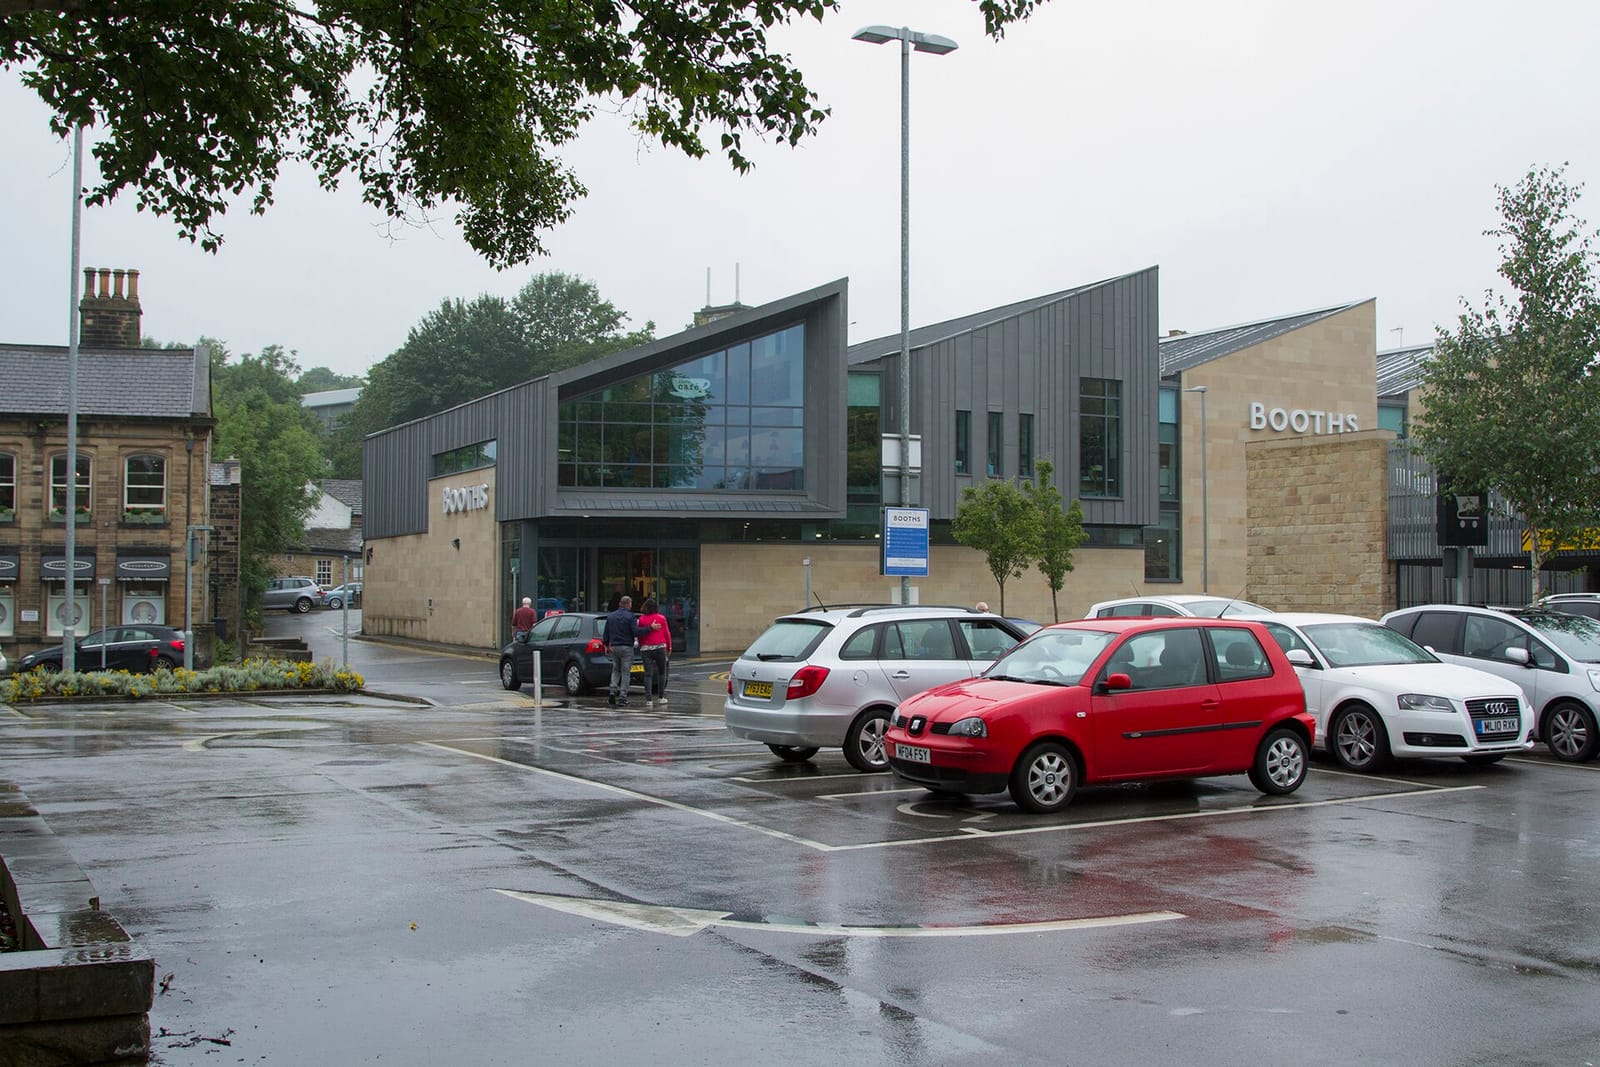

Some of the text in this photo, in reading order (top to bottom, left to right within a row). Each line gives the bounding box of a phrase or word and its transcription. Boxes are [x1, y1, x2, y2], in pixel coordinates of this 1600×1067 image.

[1249, 401, 1359, 434] BOOTHS
[442, 483, 489, 513] BOOTHS
[893, 515, 921, 523] BOOTHS
[914, 748, 928, 761] FSY
